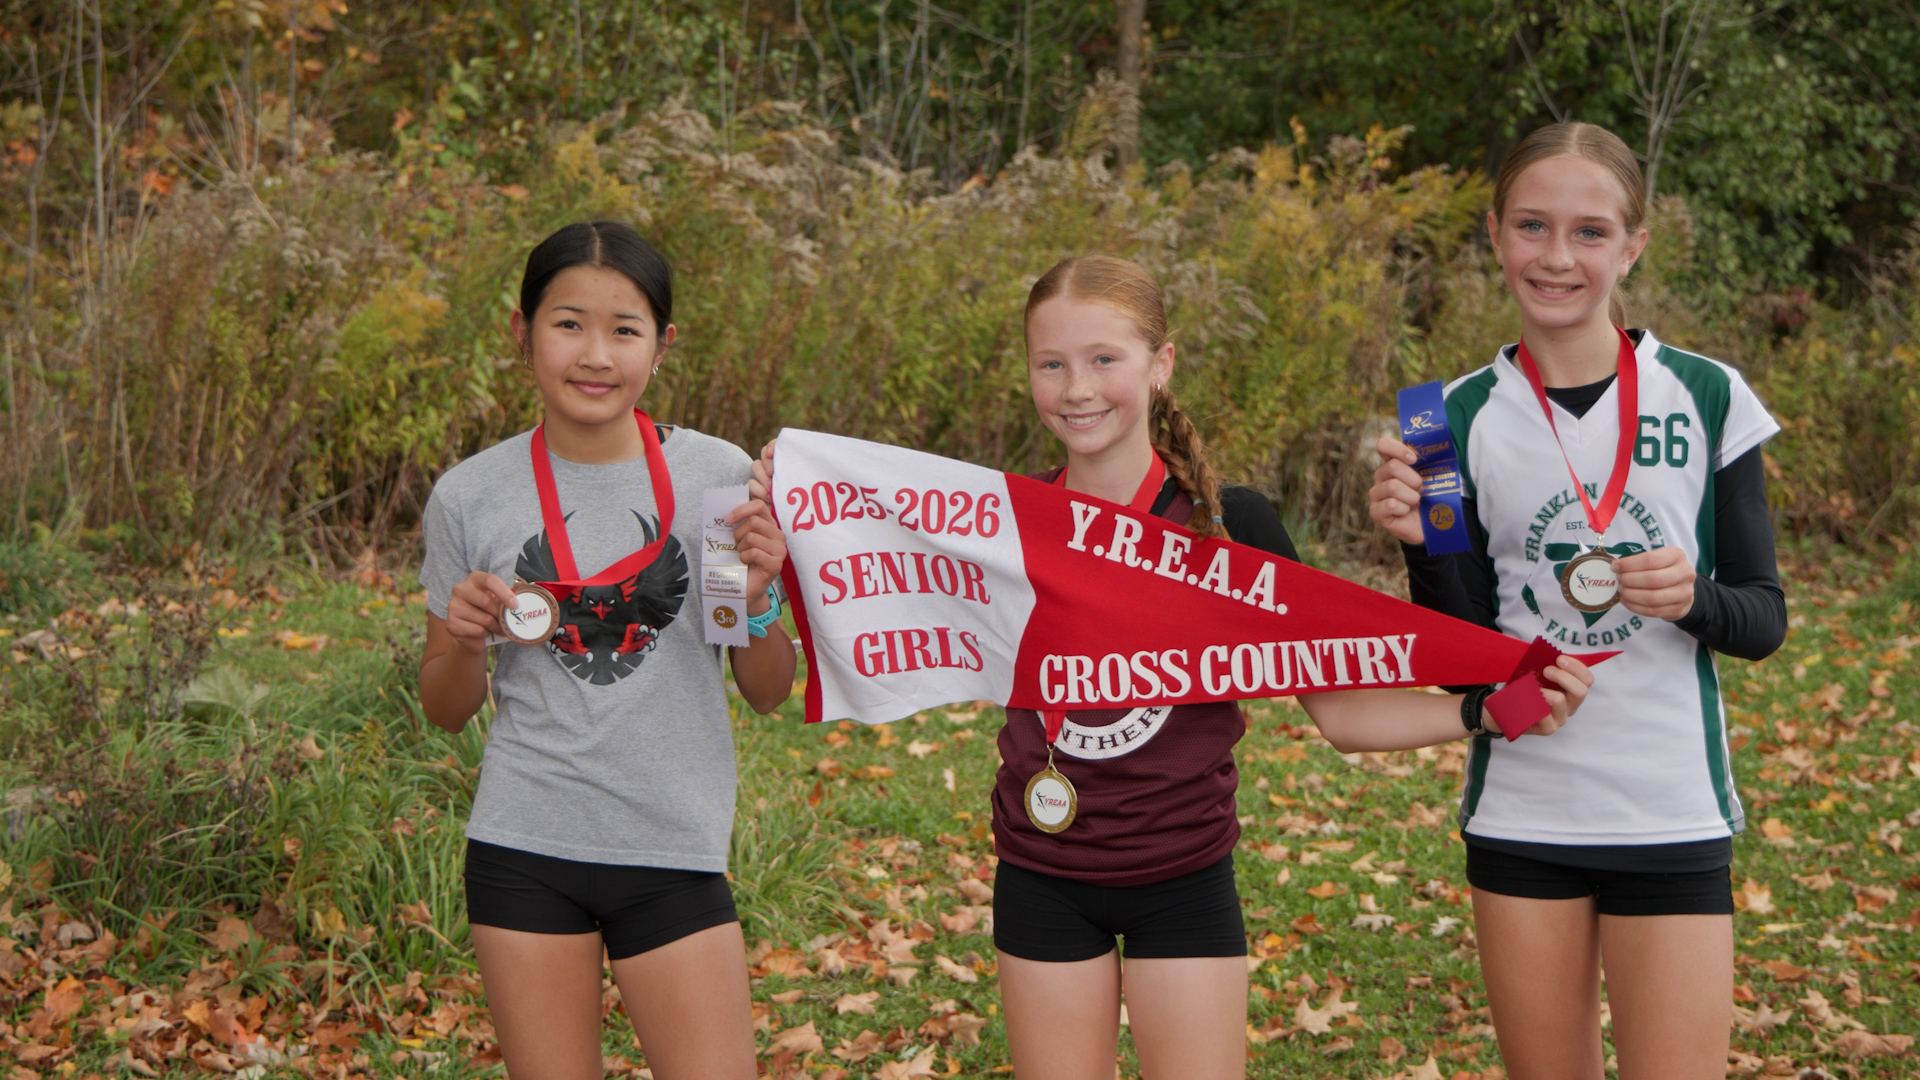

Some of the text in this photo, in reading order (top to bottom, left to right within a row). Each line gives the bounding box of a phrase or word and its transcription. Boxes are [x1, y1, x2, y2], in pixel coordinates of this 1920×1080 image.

[1633, 412, 1690, 468] 66
[787, 481, 1000, 538] 2025-2026
[1432, 509, 1453, 525] 2nd
[1565, 521, 1585, 531] EST.
[716, 543, 738, 551] YREA
[1067, 500, 1288, 615] Y.R.E.A.A.
[705, 585, 742, 595] Championships
[819, 551, 991, 606] SENIOR
[1587, 579, 1616, 587] YREAA
[522, 608, 548, 620] YREAA
[716, 609, 735, 624] 3rd
[1545, 615, 1643, 647] FALCONS
[853, 627, 984, 677] GIRLS
[1039, 634, 1417, 704] CROSS COUNTRY
[1062, 707, 1162, 750] NTHER
[1045, 798, 1067, 807] YREAA
